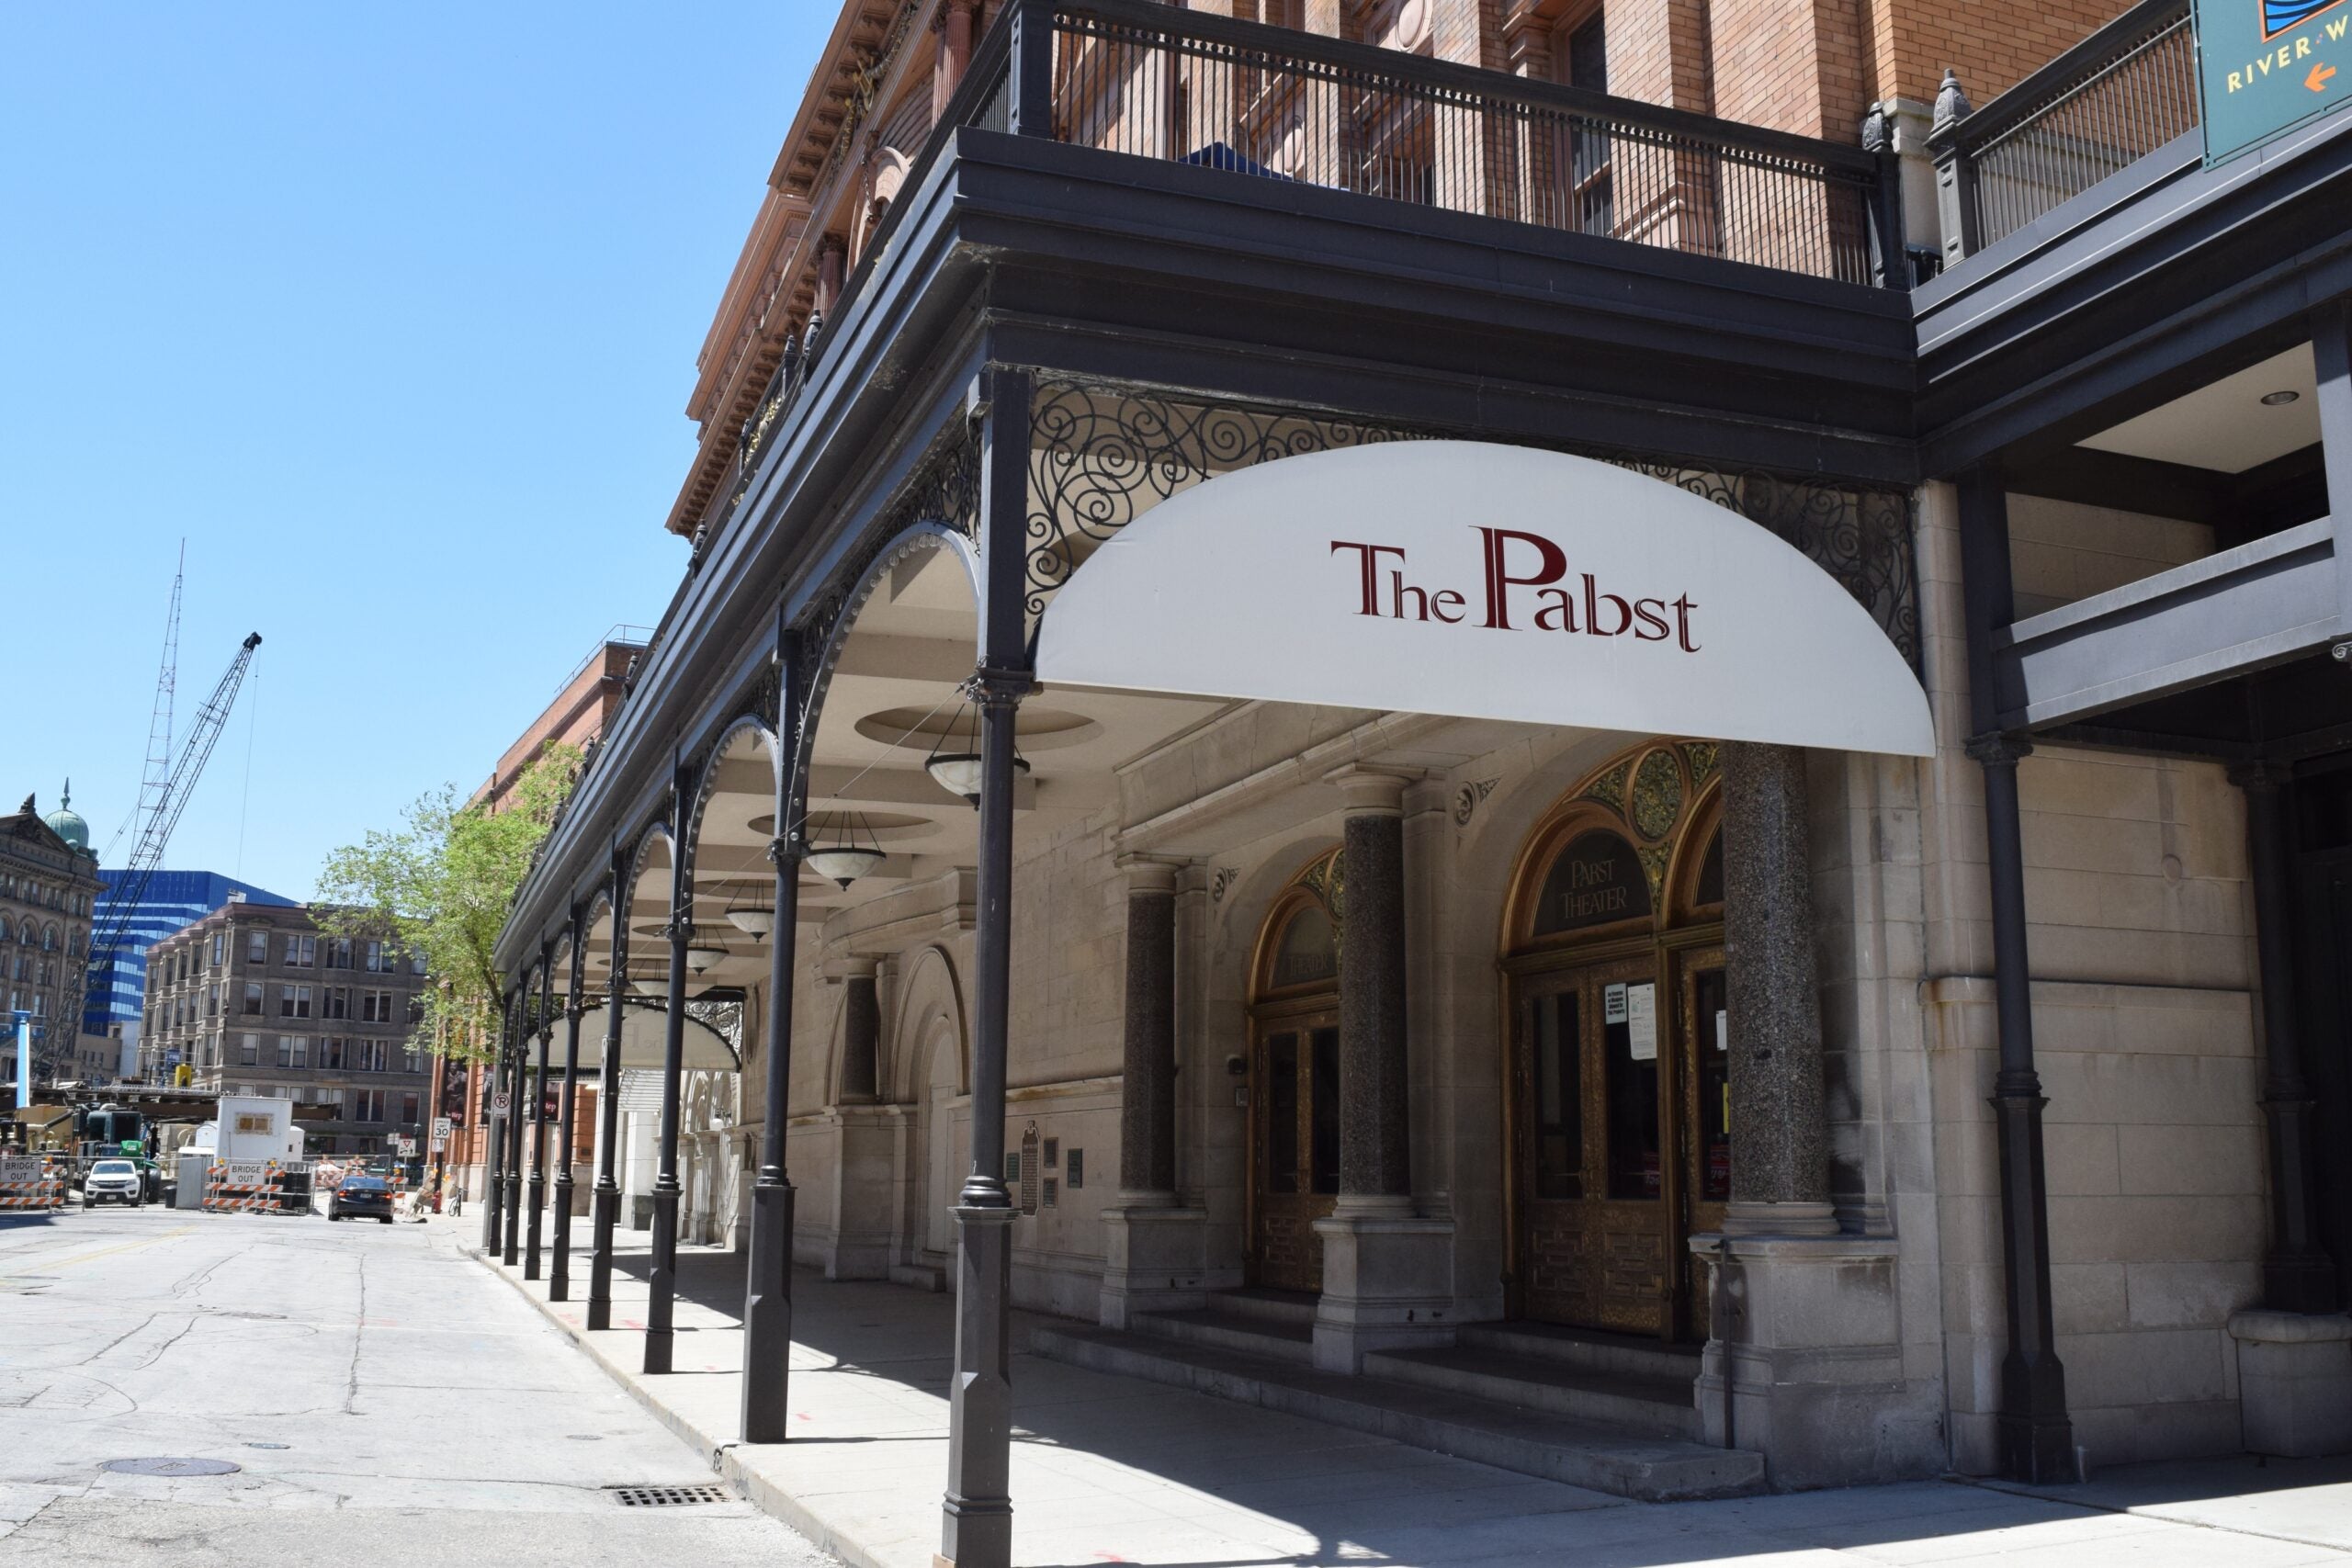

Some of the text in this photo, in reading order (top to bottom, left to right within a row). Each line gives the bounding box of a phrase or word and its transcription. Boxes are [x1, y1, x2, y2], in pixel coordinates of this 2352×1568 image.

[2227, 15, 2352, 94] RIVER W
[1330, 525, 1702, 653] The Pabst
[1572, 859, 1615, 889] PABST
[1560, 886, 1627, 919] THEATER
[435, 1128, 448, 1136] 30
[5, 1161, 36, 1170] BRIDGE
[232, 1165, 262, 1174] BRIDGE
[10, 1172, 28, 1180] OUT
